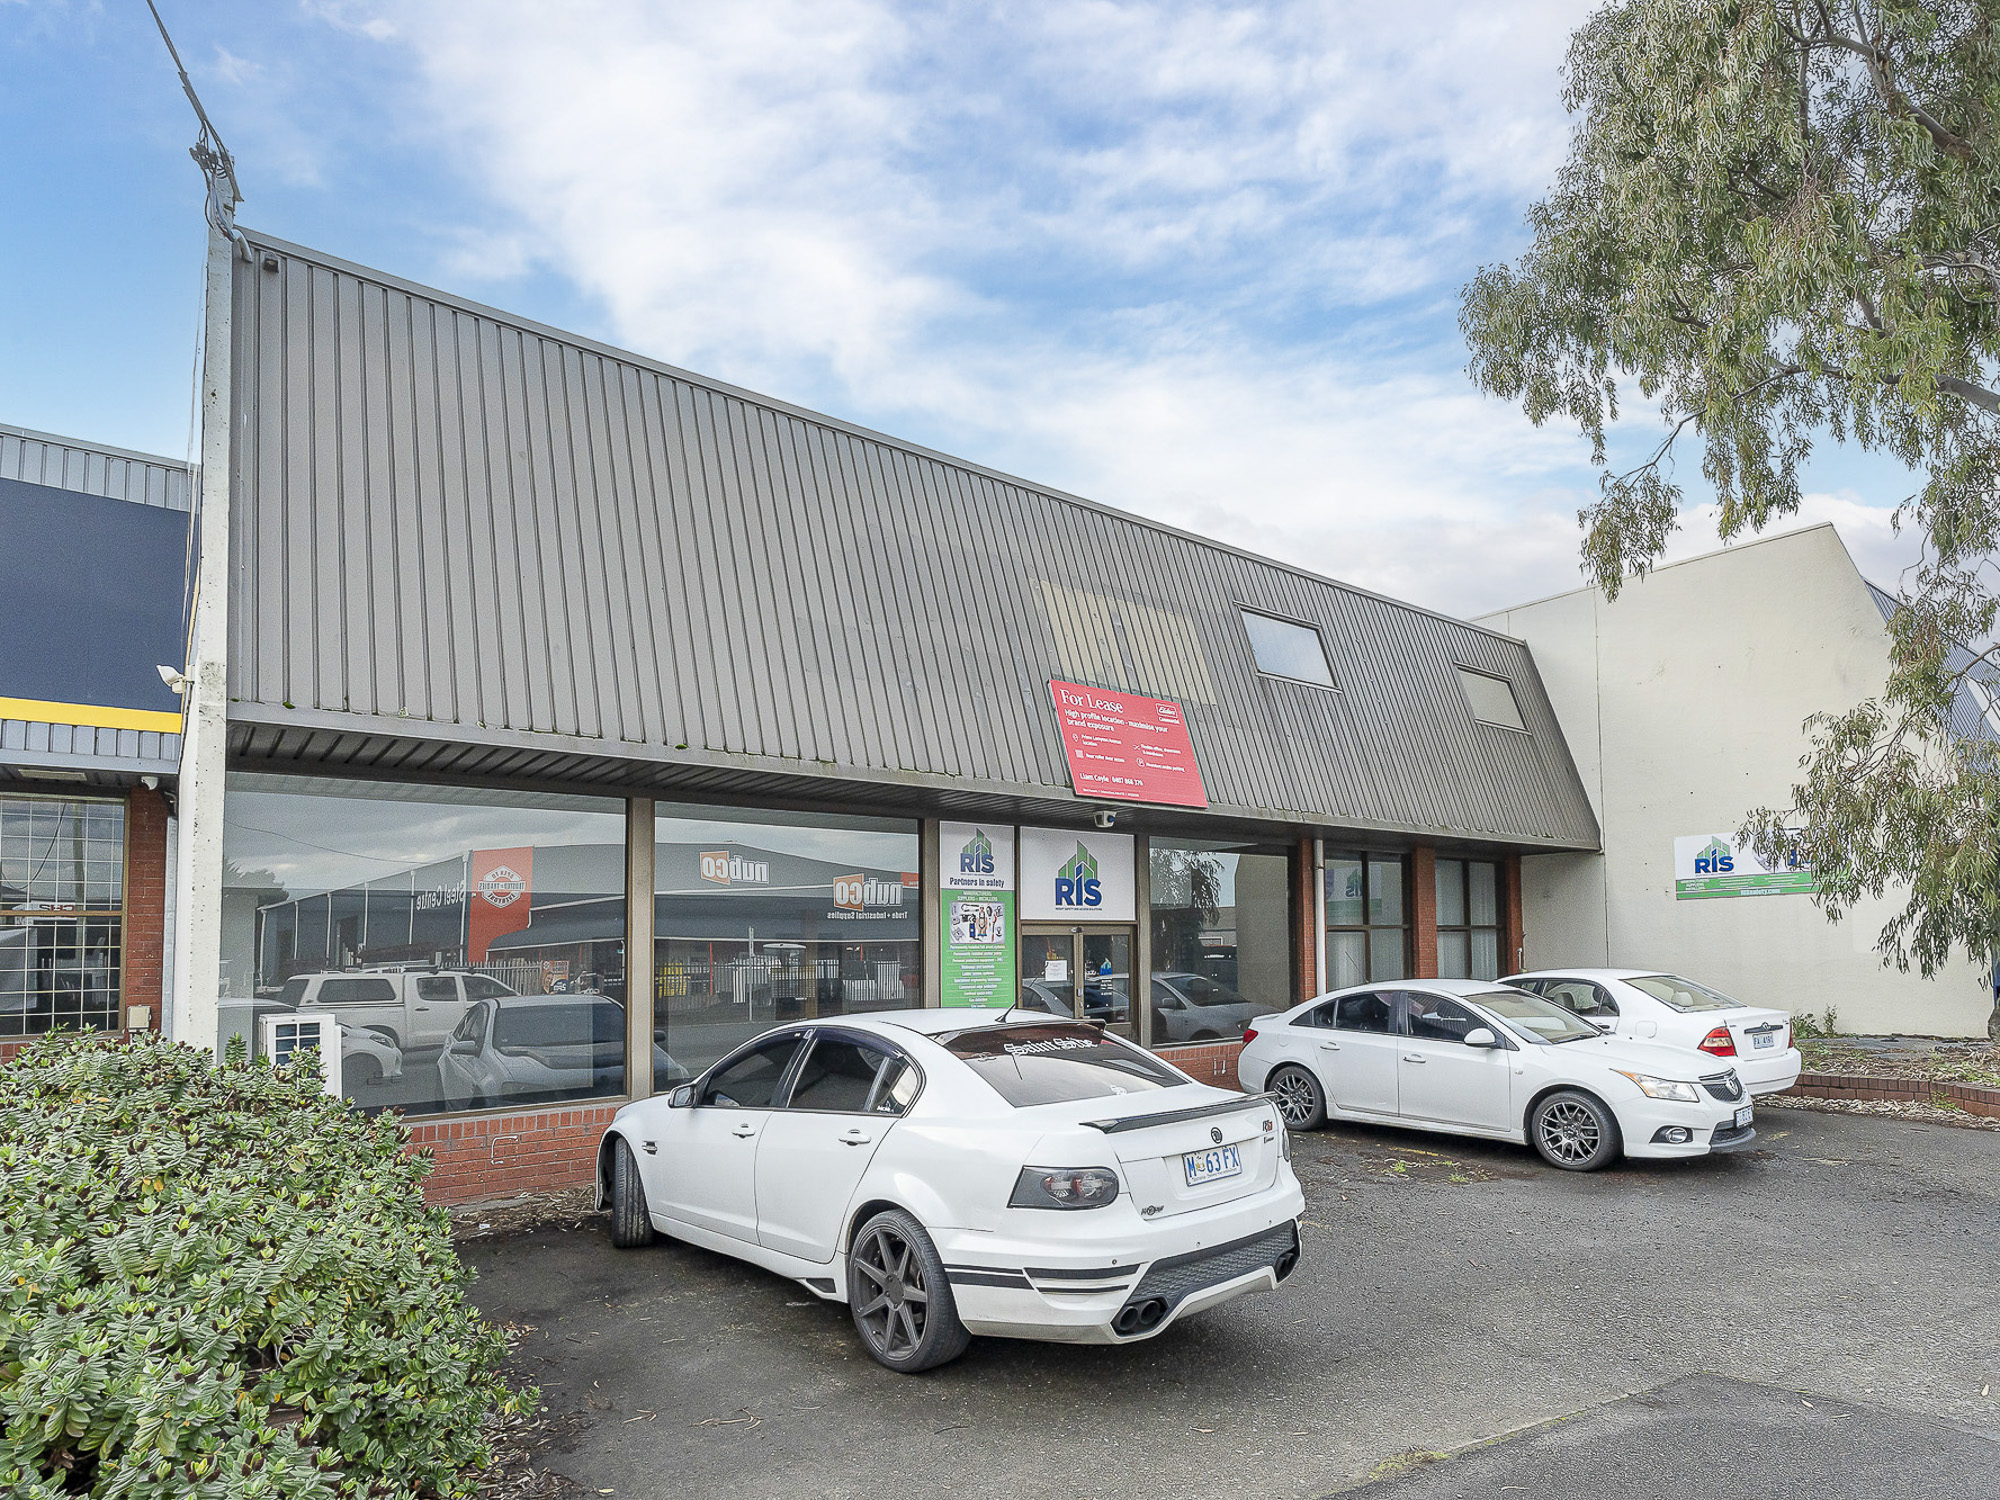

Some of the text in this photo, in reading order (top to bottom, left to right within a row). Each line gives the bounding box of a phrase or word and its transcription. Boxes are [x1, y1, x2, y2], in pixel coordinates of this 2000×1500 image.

[1060, 688, 1124, 713] For Lease
[1064, 708, 1080, 719] High
[1080, 711, 1101, 722] profile
[1101, 714, 1125, 726] location
[1154, 725, 1168, 734] your
[1066, 717, 1115, 732] brand exposure
[960, 847, 995, 873] RIS
[1694, 852, 1735, 874] RIS
[949, 877, 1005, 888] Partners in safety
[1055, 869, 1102, 906] RIS
[1186, 1156, 1197, 1178] M
[1205, 1151, 1221, 1174] 63
[1222, 1146, 1240, 1169] FX
